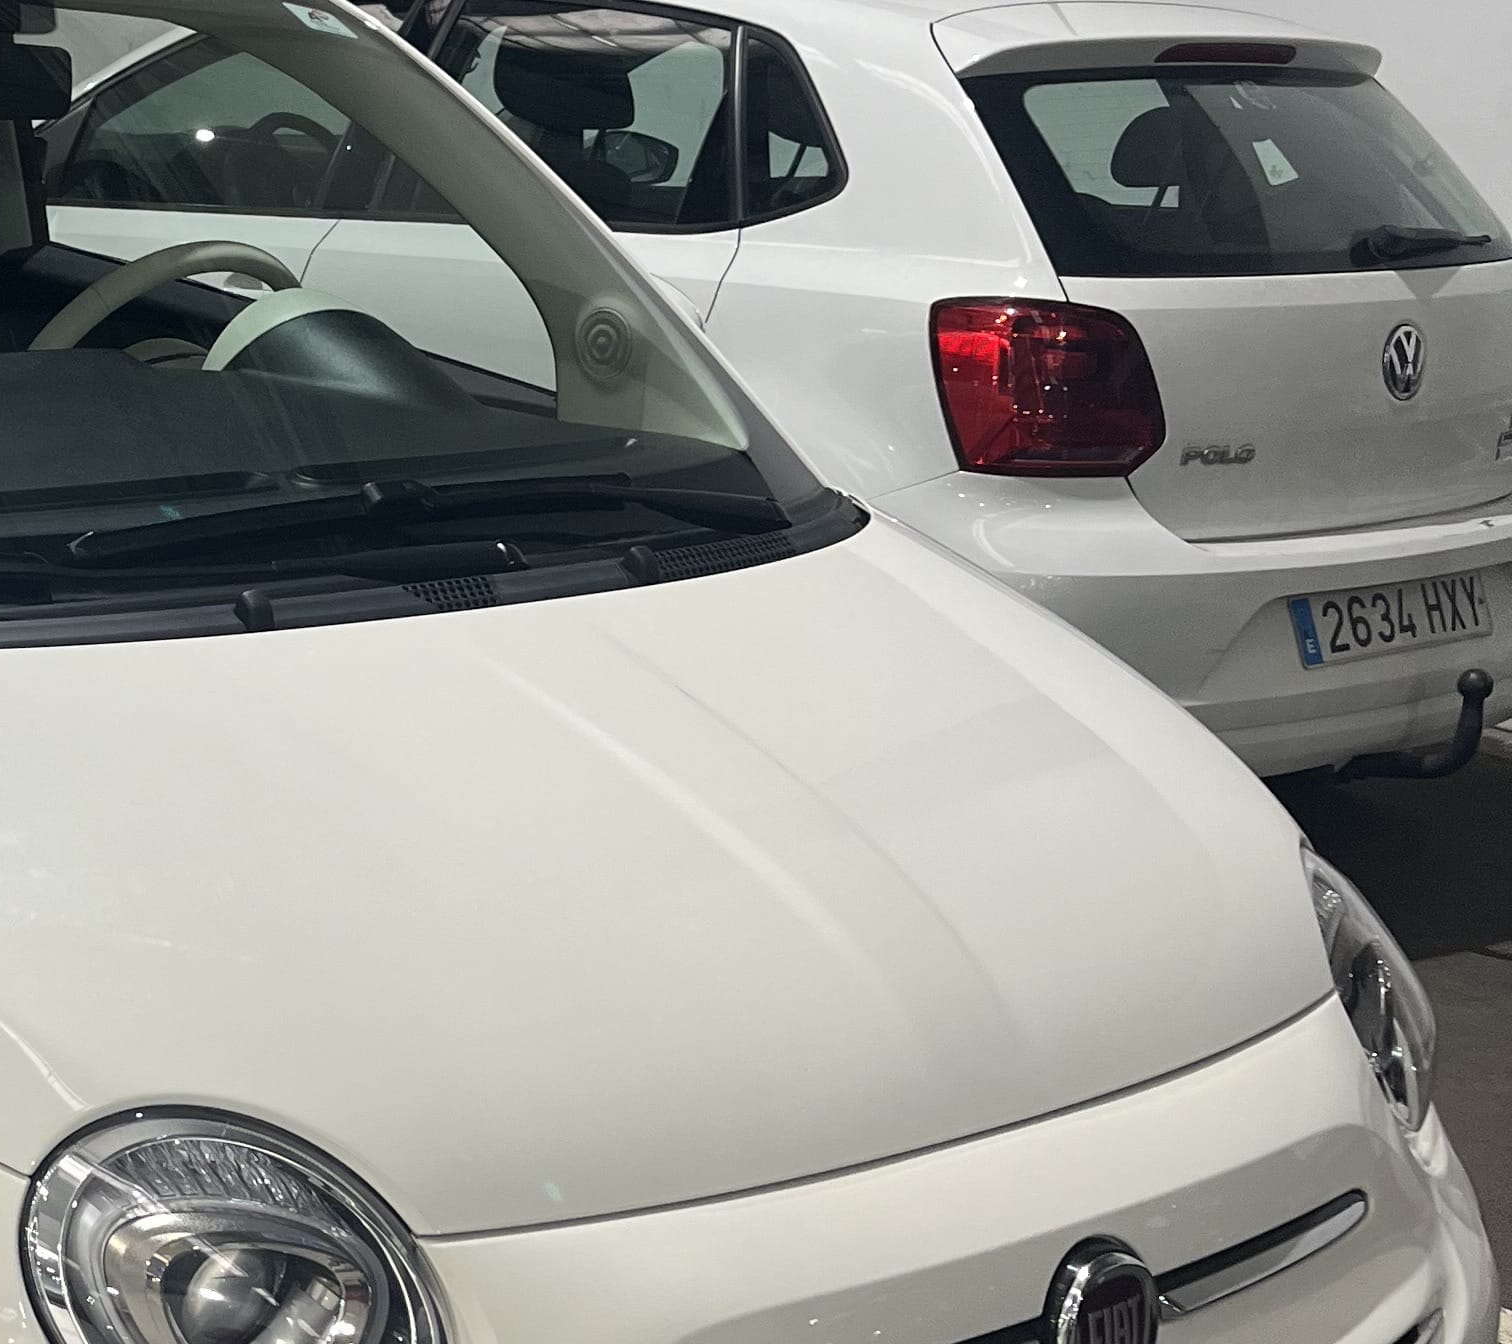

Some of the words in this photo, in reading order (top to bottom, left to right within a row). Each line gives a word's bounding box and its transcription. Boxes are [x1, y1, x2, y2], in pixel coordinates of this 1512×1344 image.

[1179, 443, 1257, 466] POLO
[1306, 638, 1317, 654] E
[1321, 587, 1418, 654] 2634
[1421, 574, 1480, 635] HXY
